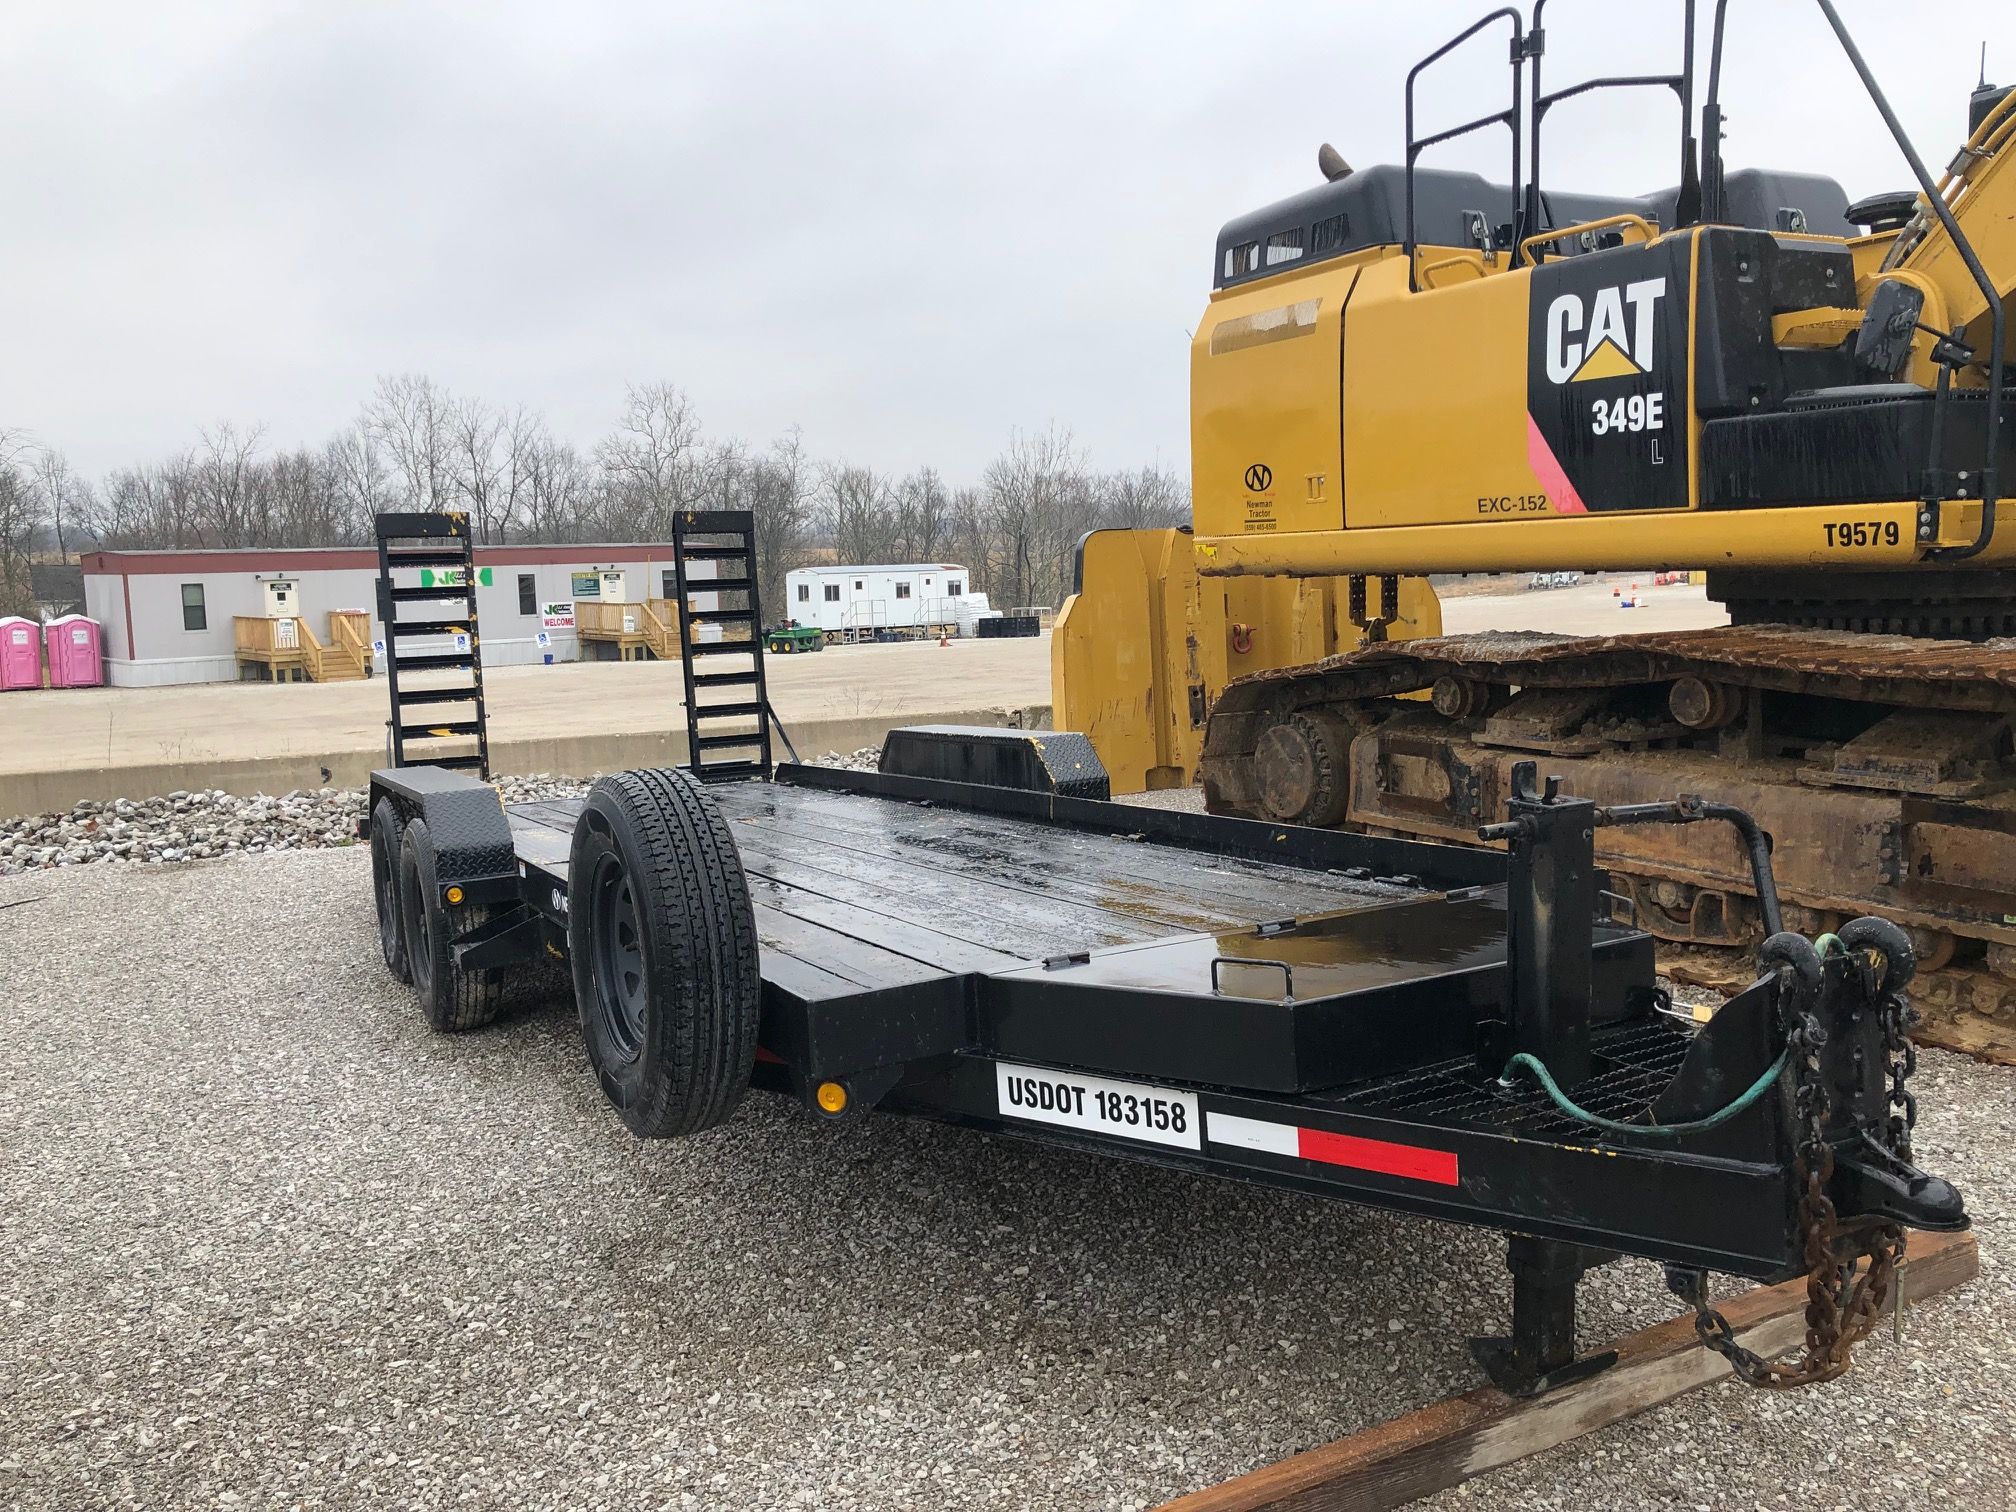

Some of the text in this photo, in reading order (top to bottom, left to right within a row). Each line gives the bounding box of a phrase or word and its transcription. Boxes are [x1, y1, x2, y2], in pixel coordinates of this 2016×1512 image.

[1546, 277, 1666, 384] CAT
[1592, 392, 1664, 436] 349E
[1651, 439, 1664, 465] L
[1246, 500, 1273, 509] Newman
[1248, 509, 1271, 518] Tractor
[1477, 494, 1548, 514] EXC-152
[1823, 520, 1900, 548] T9579
[543, 617, 575, 627] WELCOME
[1006, 1075, 1188, 1135] USDOT 183158
